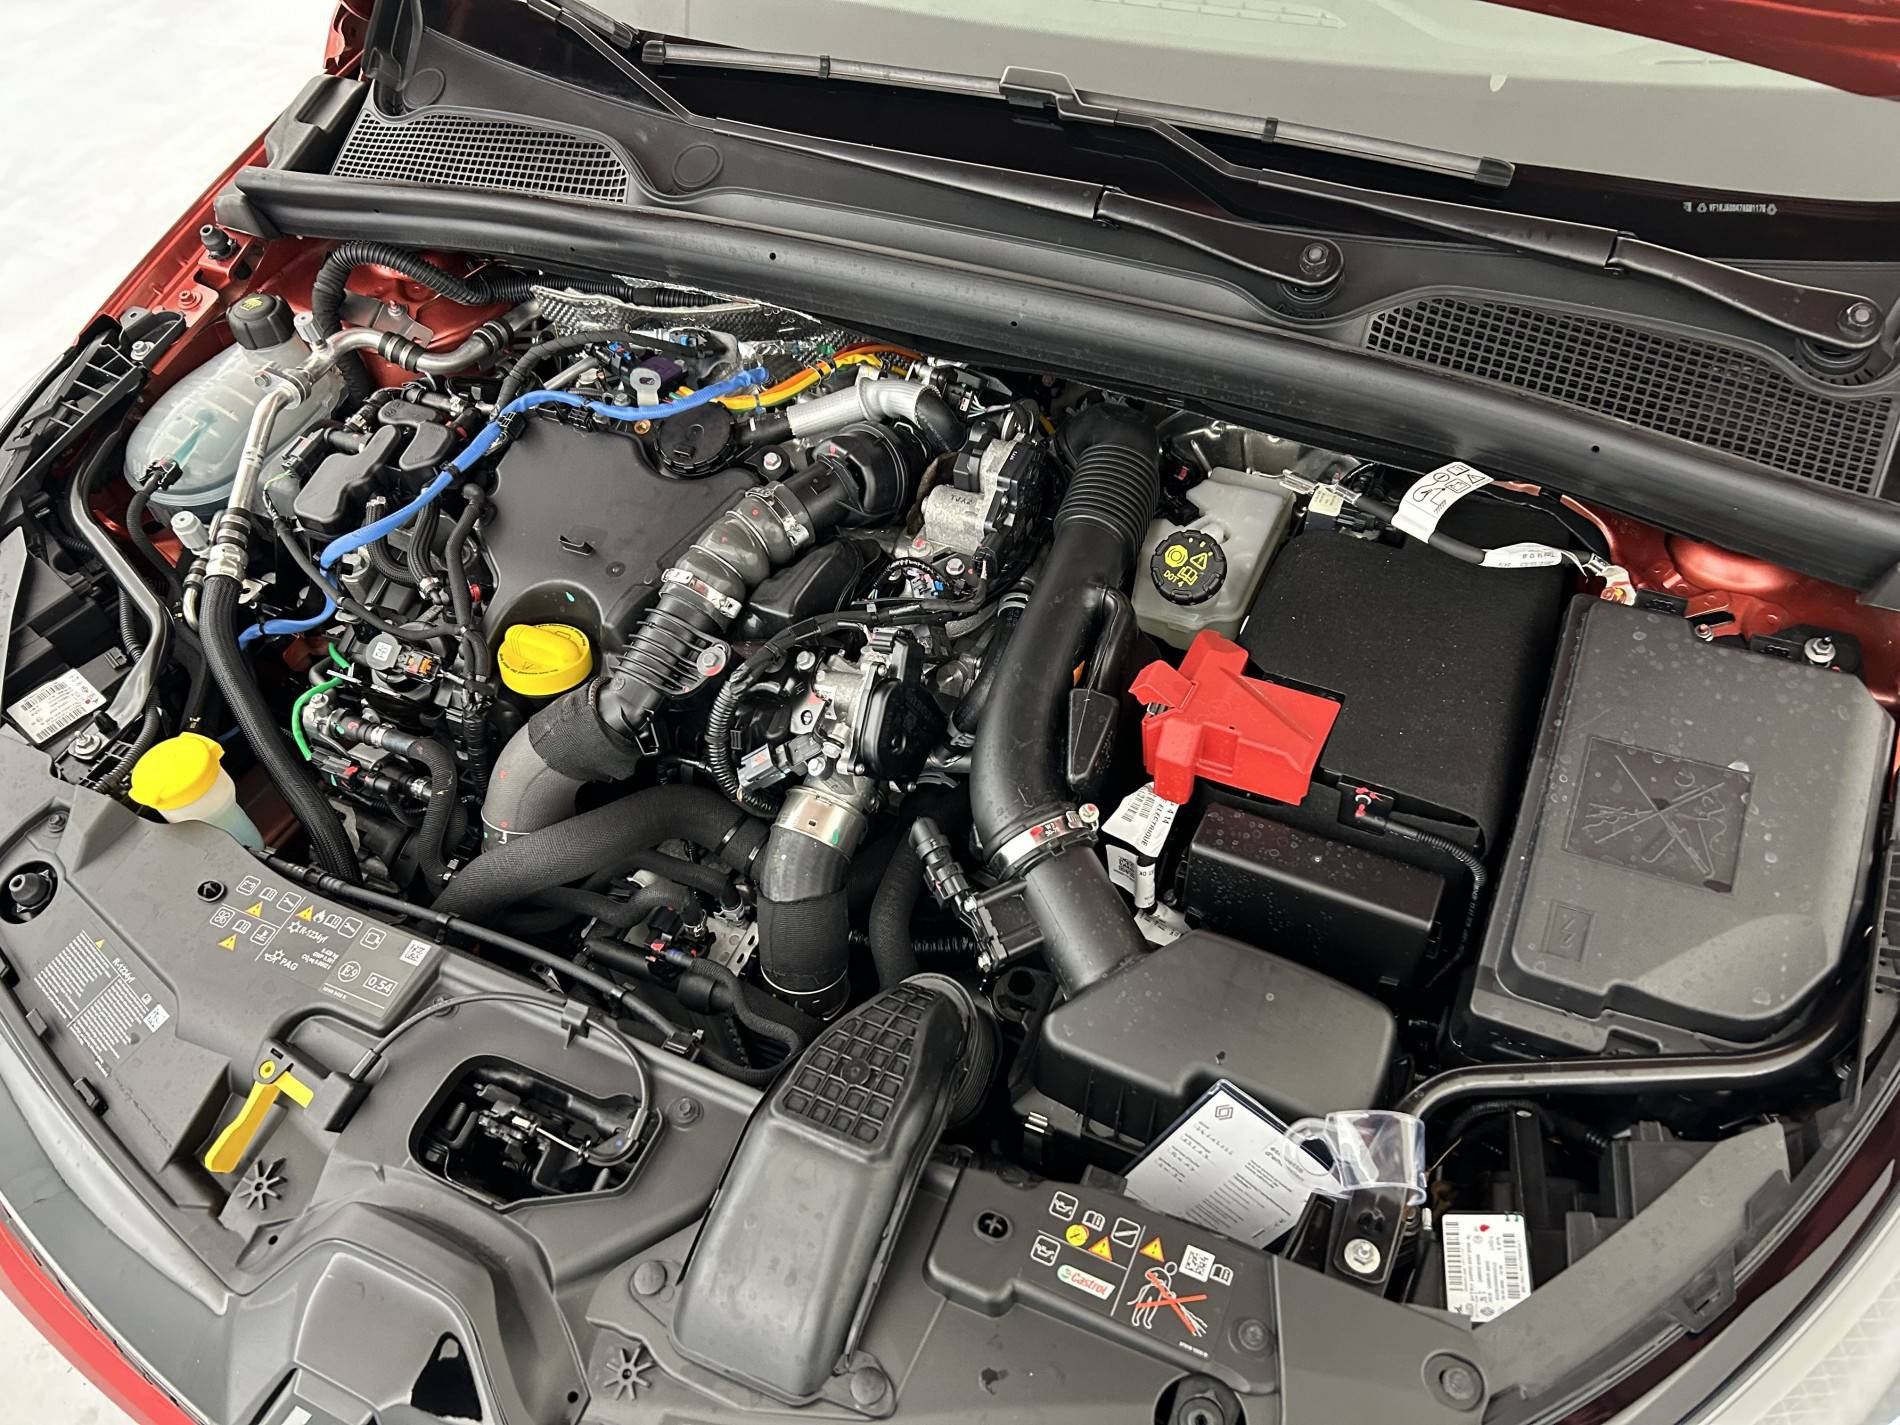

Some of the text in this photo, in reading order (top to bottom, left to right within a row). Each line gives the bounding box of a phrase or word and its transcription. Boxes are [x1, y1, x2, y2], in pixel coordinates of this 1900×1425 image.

[1163, 569, 1184, 588] DOT 4
[1140, 803, 1164, 846] ELECTRIQUE
[299, 926, 328, 943] R-1234yf
[280, 957, 298, 971] PAG
[340, 964, 358, 978] E9
[368, 976, 394, 993] 0,54
[1071, 1272, 1108, 1296] Castrol
